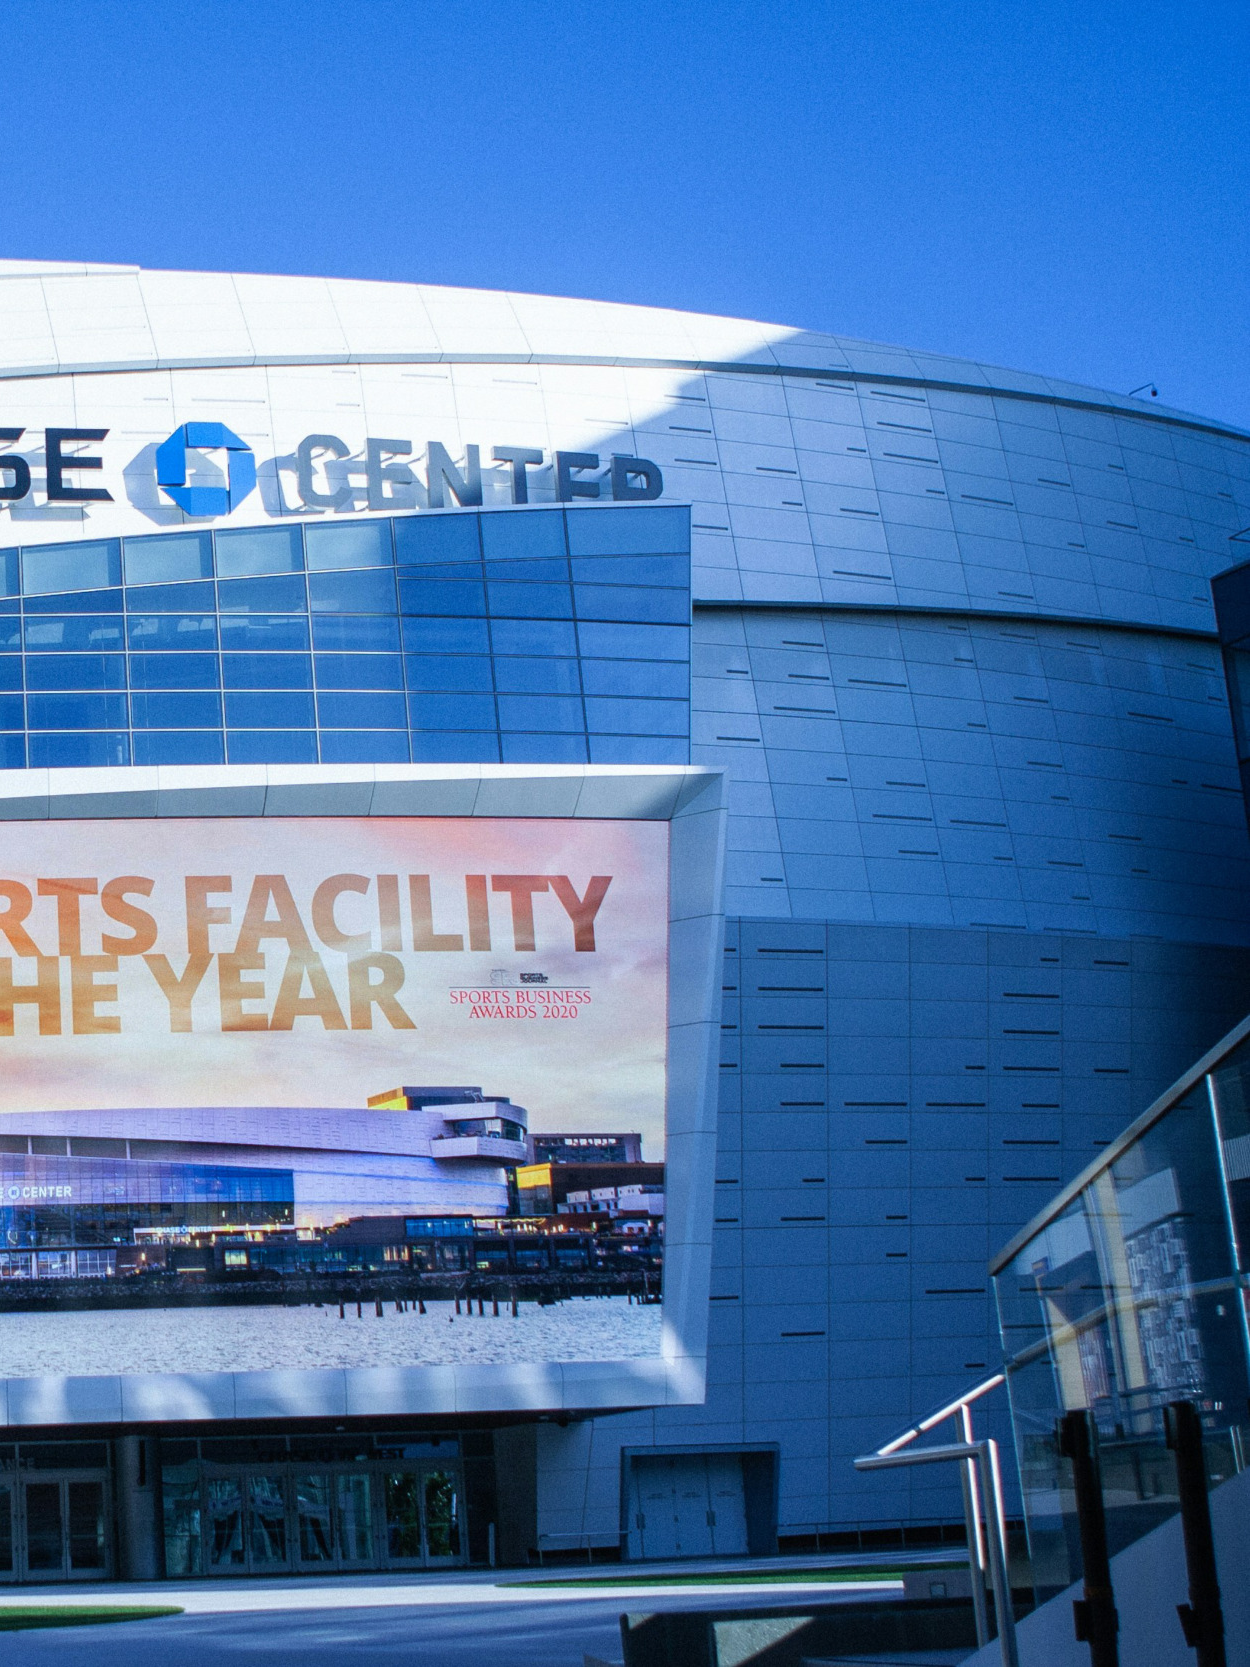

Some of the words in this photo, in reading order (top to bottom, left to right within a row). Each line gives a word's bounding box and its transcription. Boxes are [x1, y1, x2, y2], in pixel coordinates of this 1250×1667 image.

[185, 873, 613, 953] FACILITY
[142, 951, 417, 1033] YEAR
[450, 990, 510, 1004] SPORTS
[515, 990, 591, 1004] BUSINESS
[469, 1005, 536, 1018] AWARDS
[543, 1005, 578, 1018] 2020
[22, 1186, 72, 1198] CENTER
